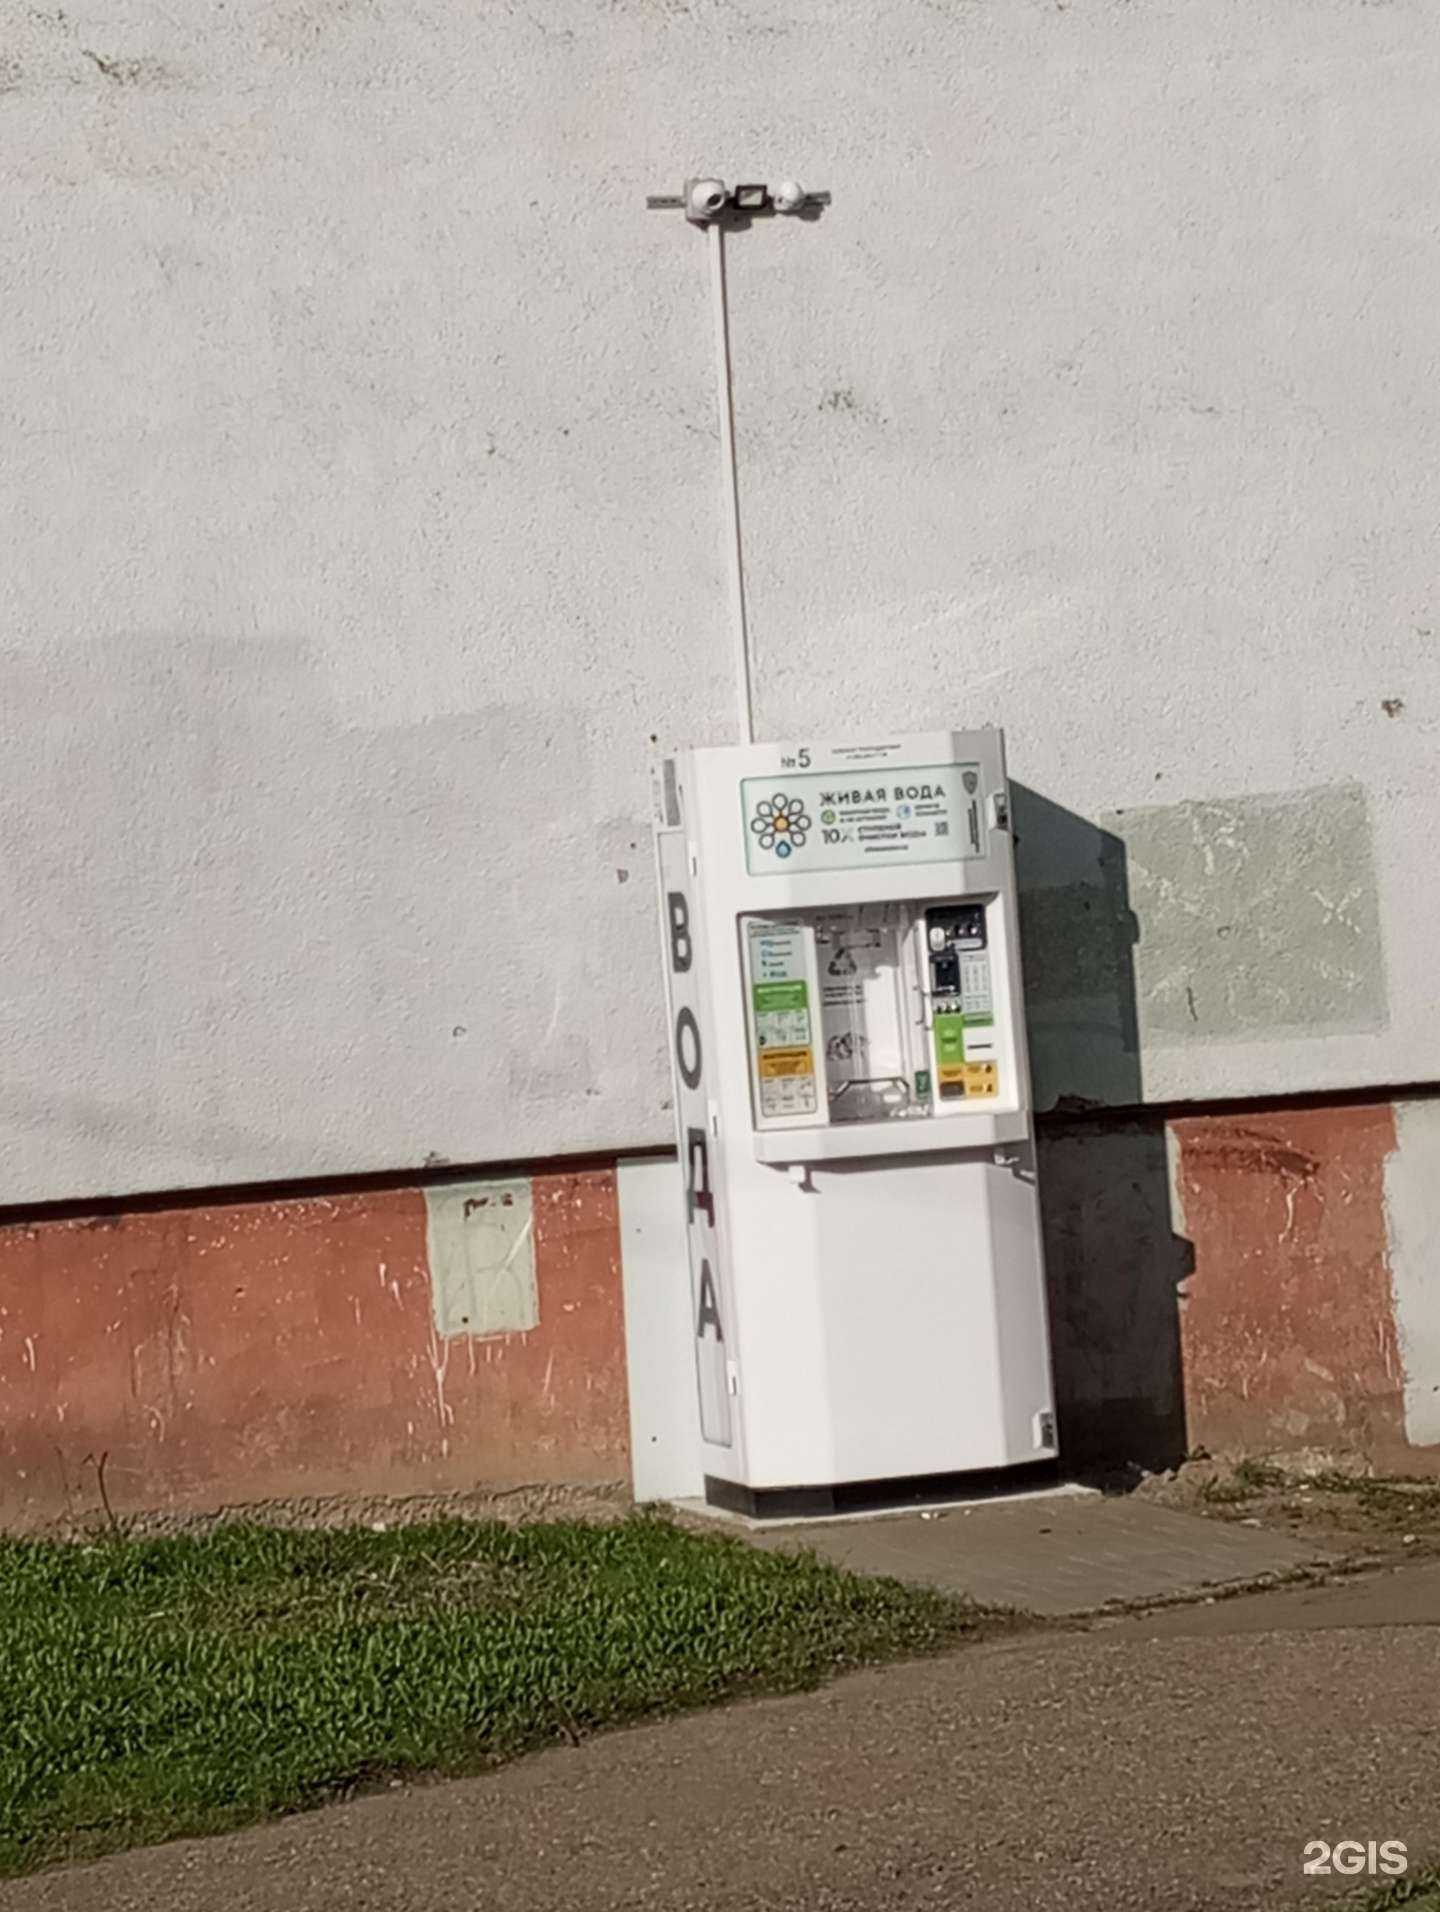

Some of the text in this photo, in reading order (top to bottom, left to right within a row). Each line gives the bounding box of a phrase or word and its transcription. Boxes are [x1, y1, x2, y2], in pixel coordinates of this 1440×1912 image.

[819, 784, 946, 806] ЖИВАЯ ВОДА
[667, 891, 723, 1343] ВОДА
